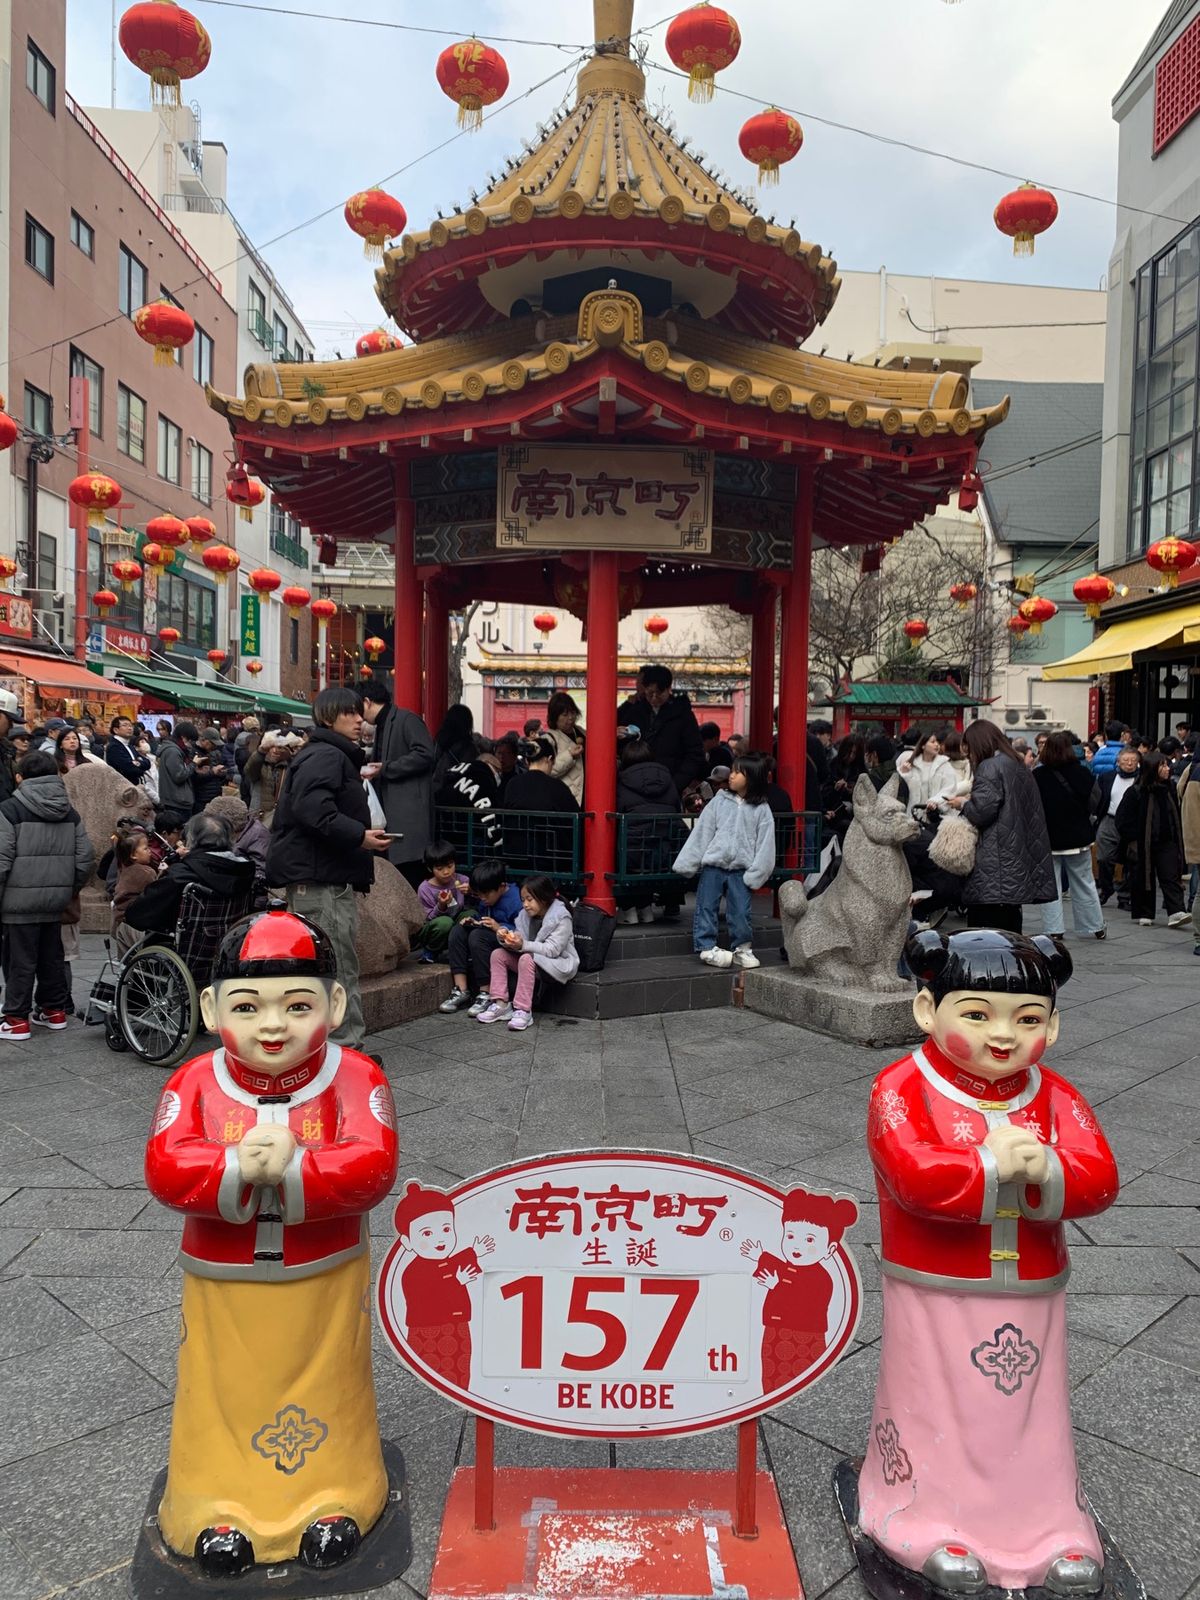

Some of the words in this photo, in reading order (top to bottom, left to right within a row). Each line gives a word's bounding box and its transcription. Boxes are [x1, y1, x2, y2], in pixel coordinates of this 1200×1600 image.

[510, 468, 701, 521] 南京町
[223, 1119, 245, 1142] 財
[302, 1118, 324, 1141] 財
[509, 1181, 728, 1240] 南京町
[581, 1237, 659, 1268] 生誕
[557, 1383, 592, 1409] BE
[601, 1383, 675, 1410] KOBE
